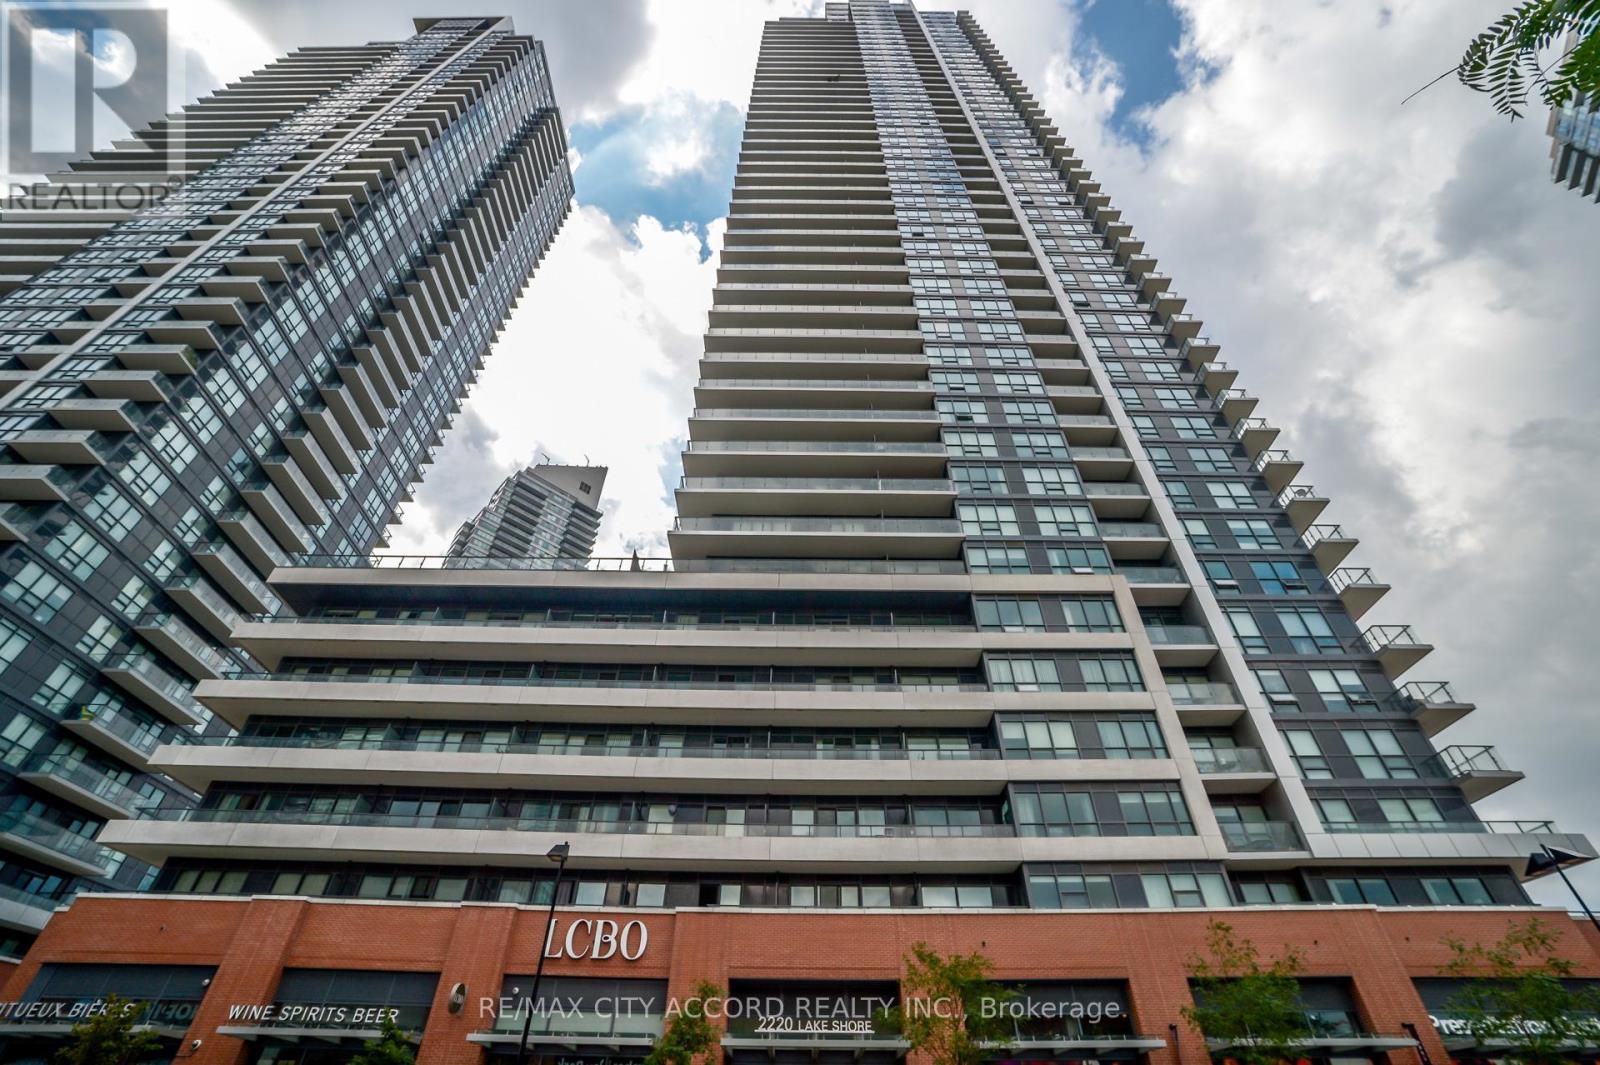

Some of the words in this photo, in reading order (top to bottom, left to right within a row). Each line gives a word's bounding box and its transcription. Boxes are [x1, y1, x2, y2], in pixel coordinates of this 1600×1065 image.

[544, 919, 648, 960] LCBO
[67, 999, 136, 1019] BIÈRS
[229, 1004, 275, 1021] WINE
[279, 1006, 348, 1023] SPIRITS
[351, 1007, 400, 1024] BEER
[758, 1017, 794, 1031] 2220
[797, 1020, 830, 1032] LAKE
[831, 1020, 873, 1032] SHORE
